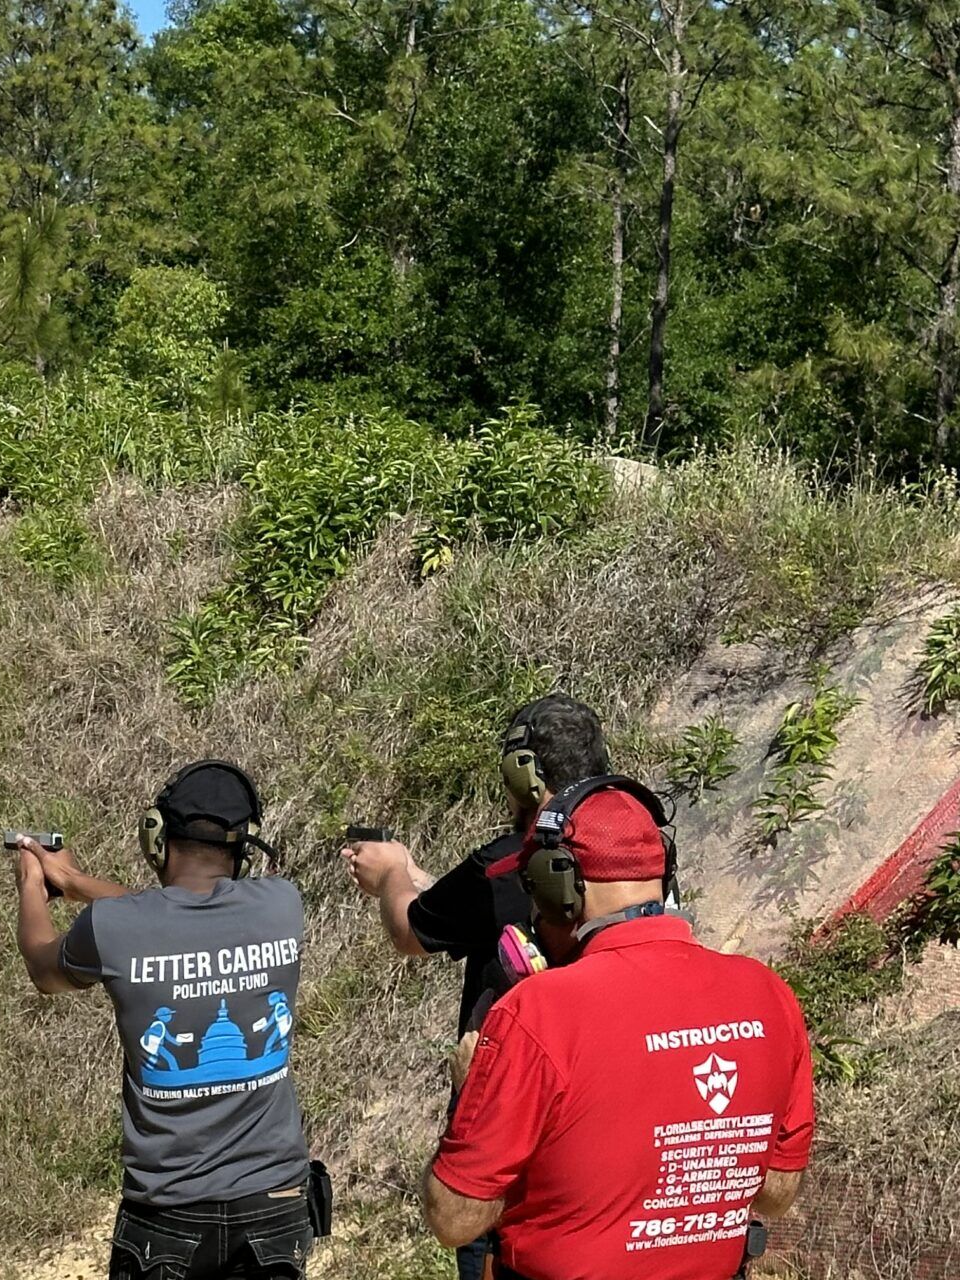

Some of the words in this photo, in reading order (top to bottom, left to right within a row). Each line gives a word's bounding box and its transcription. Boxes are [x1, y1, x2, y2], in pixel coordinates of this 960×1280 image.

[130, 951, 212, 983] LETTER
[217, 937, 299, 975] CARRIER
[173, 978, 237, 1000] POLITICAL
[239, 972, 269, 992] FUND
[645, 1020, 765, 1053] INSTRUCTOR
[142, 1086, 182, 1099] DELIVERING
[211, 1082, 246, 1096] MESSAGE
[247, 1080, 258, 1092] TO
[664, 1133, 701, 1146] FIREARMS
[704, 1129, 744, 1141] DEFENSIVE
[661, 1145, 714, 1162] SECURITY
[719, 1141, 768, 1156] LICENSING
[666, 1169, 721, 1184] G-ARMED
[726, 1165, 760, 1179] GUARD
[668, 1156, 738, 1173] D-UNARMED
[643, 1196, 689, 1210] CONCEAL
[692, 1191, 722, 1205] CARRY
[724, 1188, 744, 1201] GUN
